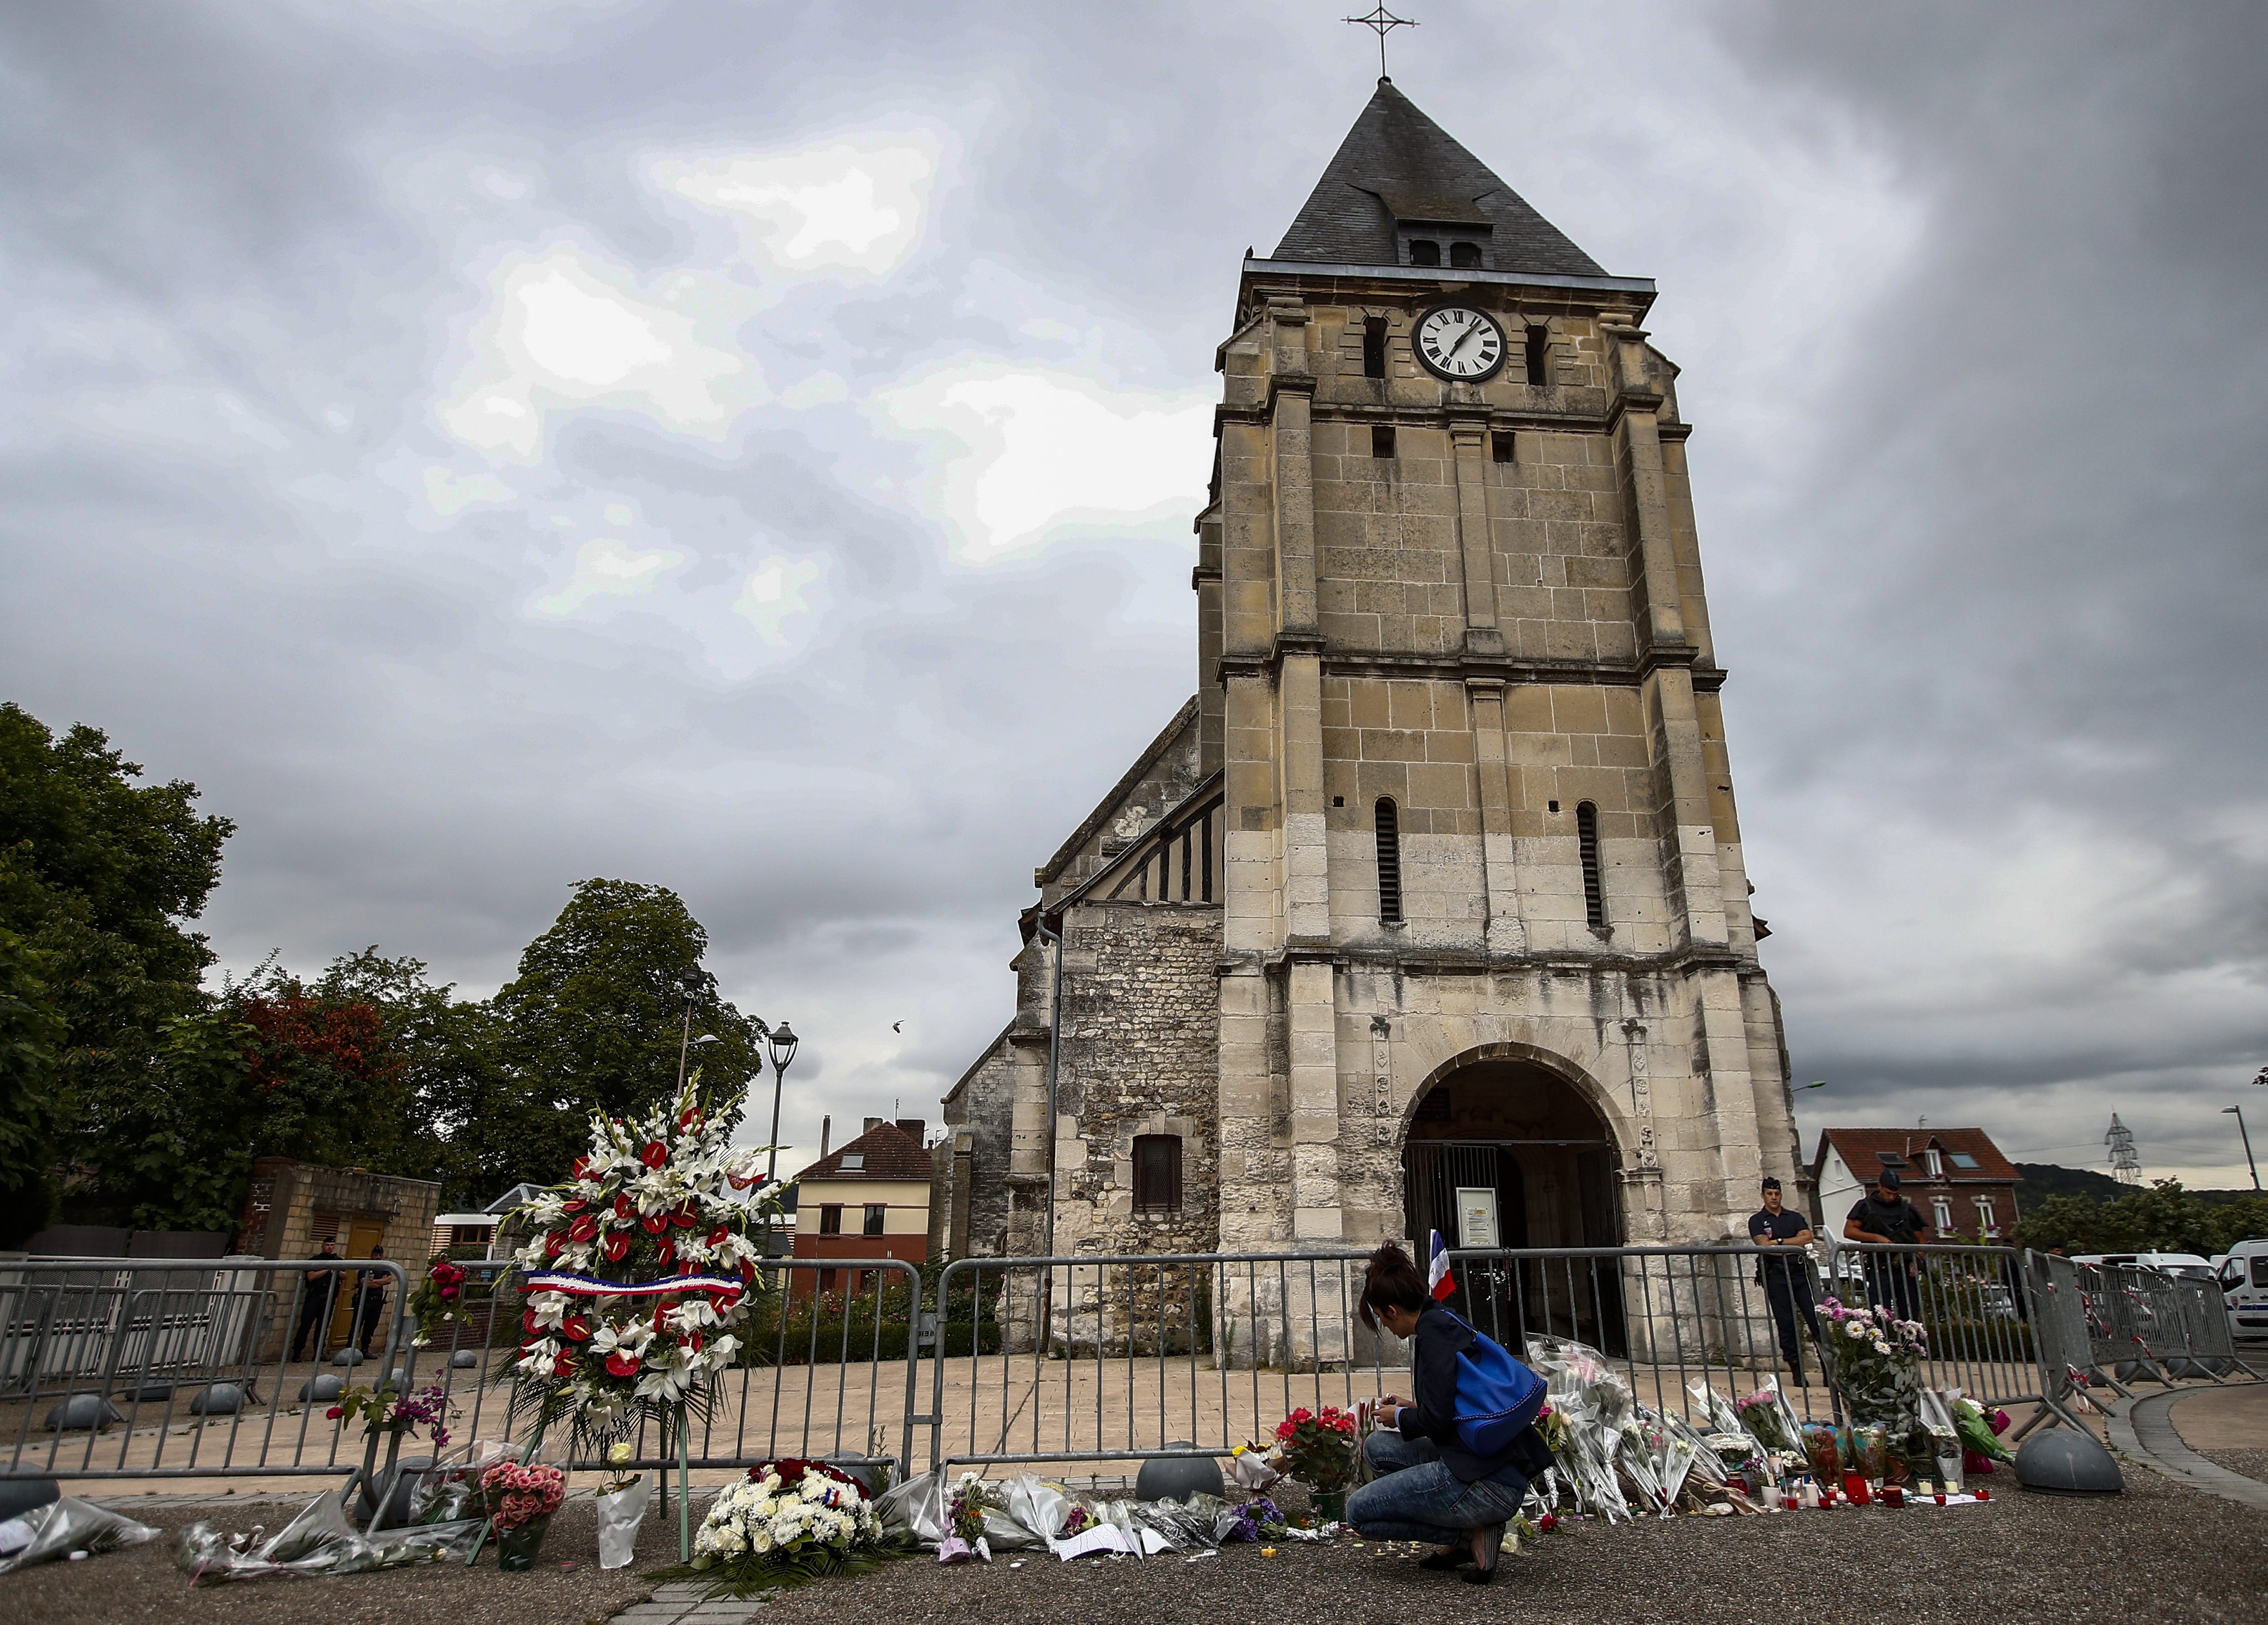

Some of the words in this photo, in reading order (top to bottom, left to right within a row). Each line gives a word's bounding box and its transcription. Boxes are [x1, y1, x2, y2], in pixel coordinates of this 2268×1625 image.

[1436, 312, 1451, 327] XI
[1452, 311, 1464, 324] XII
[1469, 316, 1478, 327] I
[1426, 322, 1441, 333] X
[1477, 326, 1493, 336] II
[1423, 336, 1437, 344] IX
[1482, 339, 1497, 348] III
[1426, 345, 1443, 360] VIII
[1439, 355, 1452, 370] VII
[1457, 361, 1467, 374] VI
[1471, 359, 1483, 372] V
